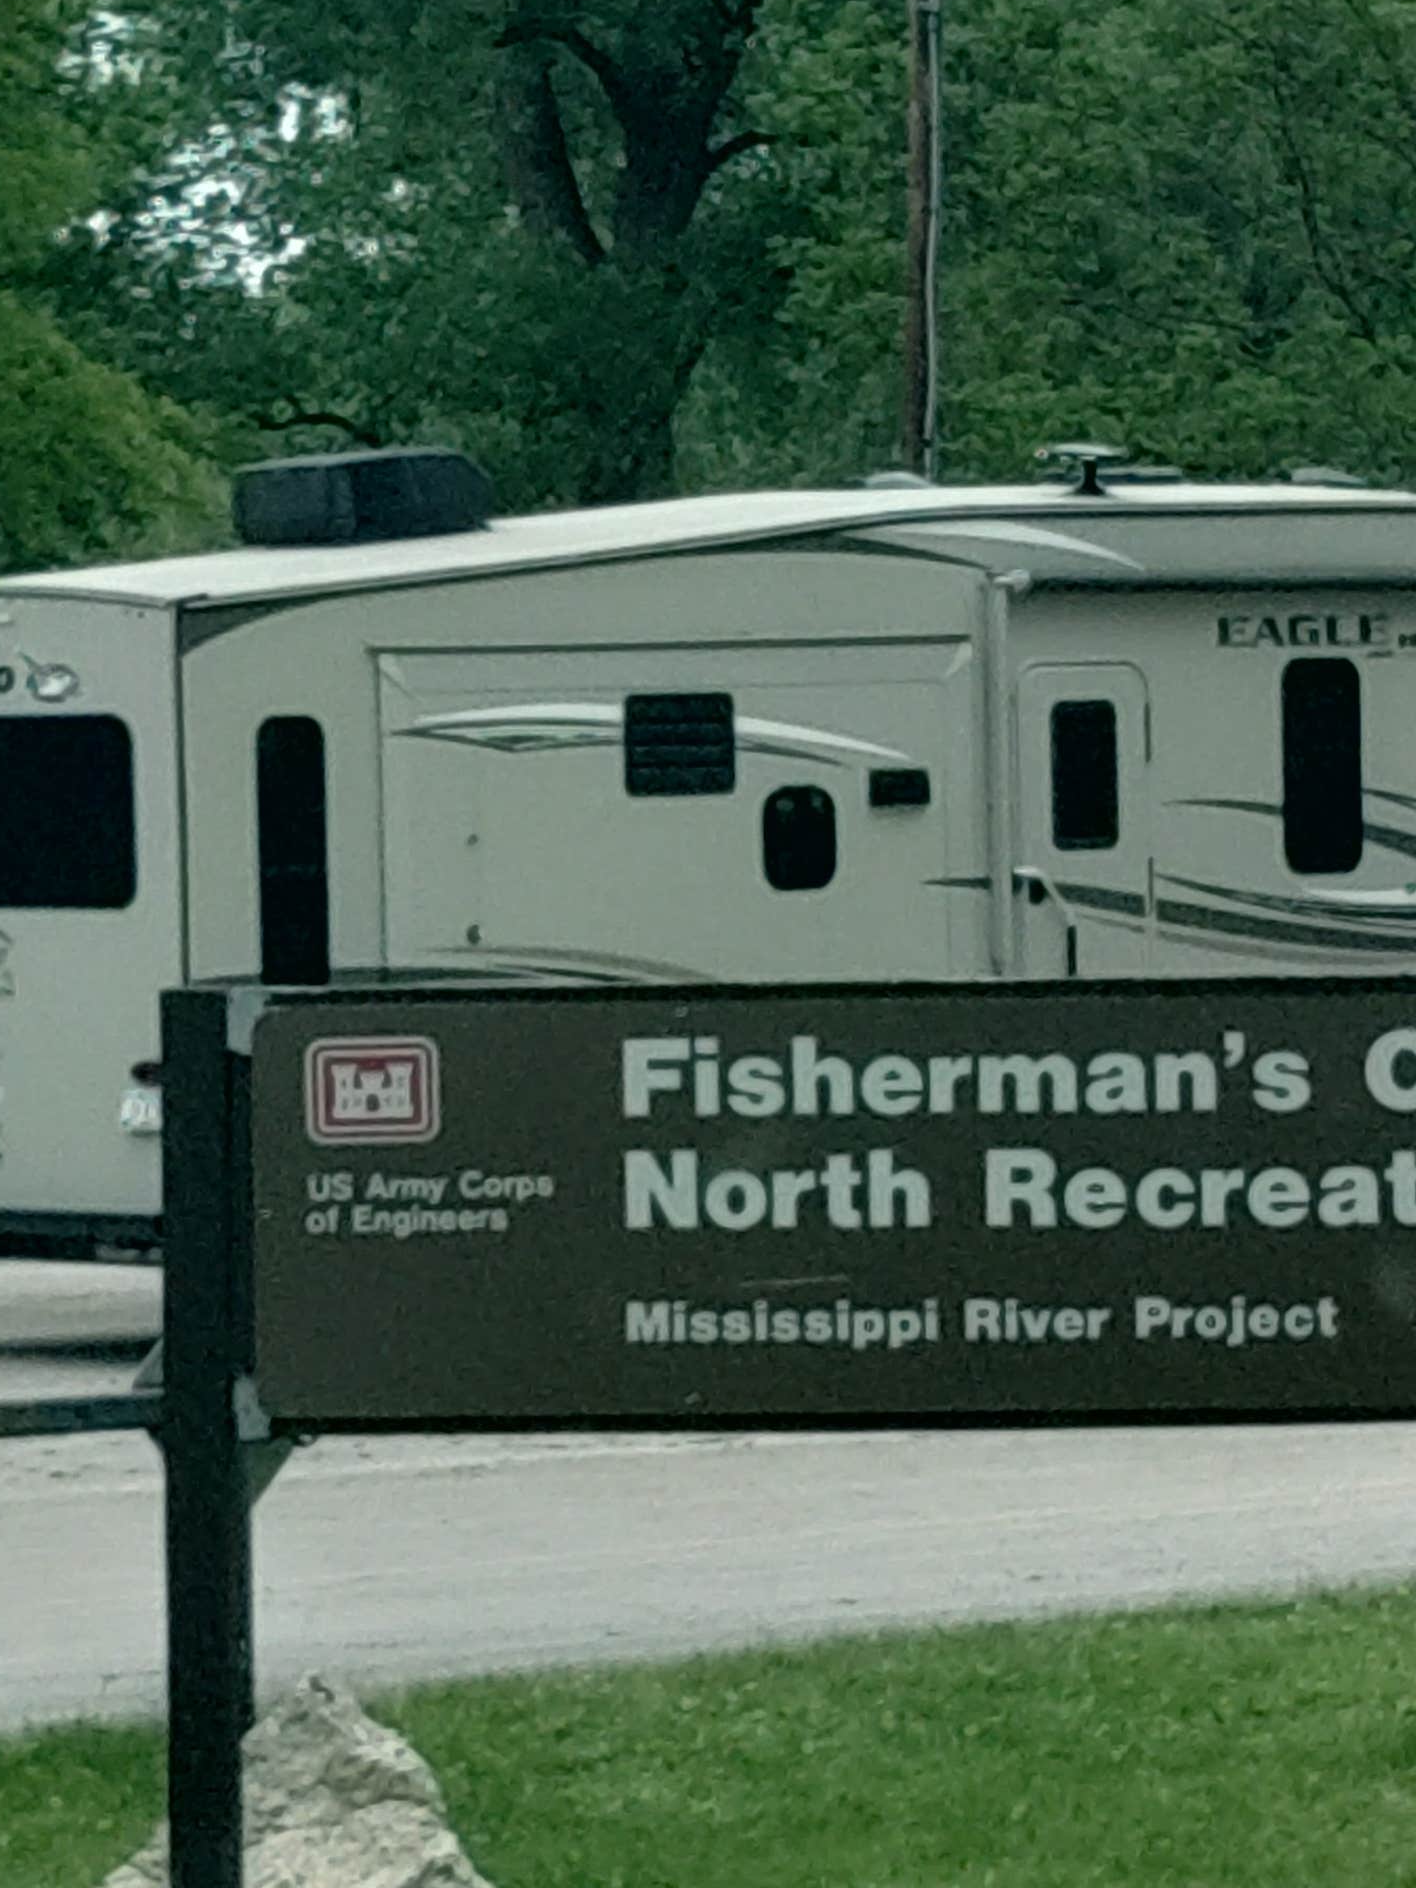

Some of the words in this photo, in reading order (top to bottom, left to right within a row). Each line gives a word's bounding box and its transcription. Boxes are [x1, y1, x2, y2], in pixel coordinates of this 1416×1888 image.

[1216, 614, 1391, 647] EAGLE
[621, 1031, 1312, 1118] Fisherman's
[306, 1172, 354, 1203] US
[364, 1171, 449, 1205] Army
[458, 1169, 555, 1203] Corps
[623, 1148, 932, 1231] North
[304, 1206, 339, 1235] of
[350, 1204, 509, 1240] Engineers
[625, 1298, 939, 1351] Mississippi
[964, 1298, 1111, 1342] River
[1134, 1295, 1339, 1348] Project
